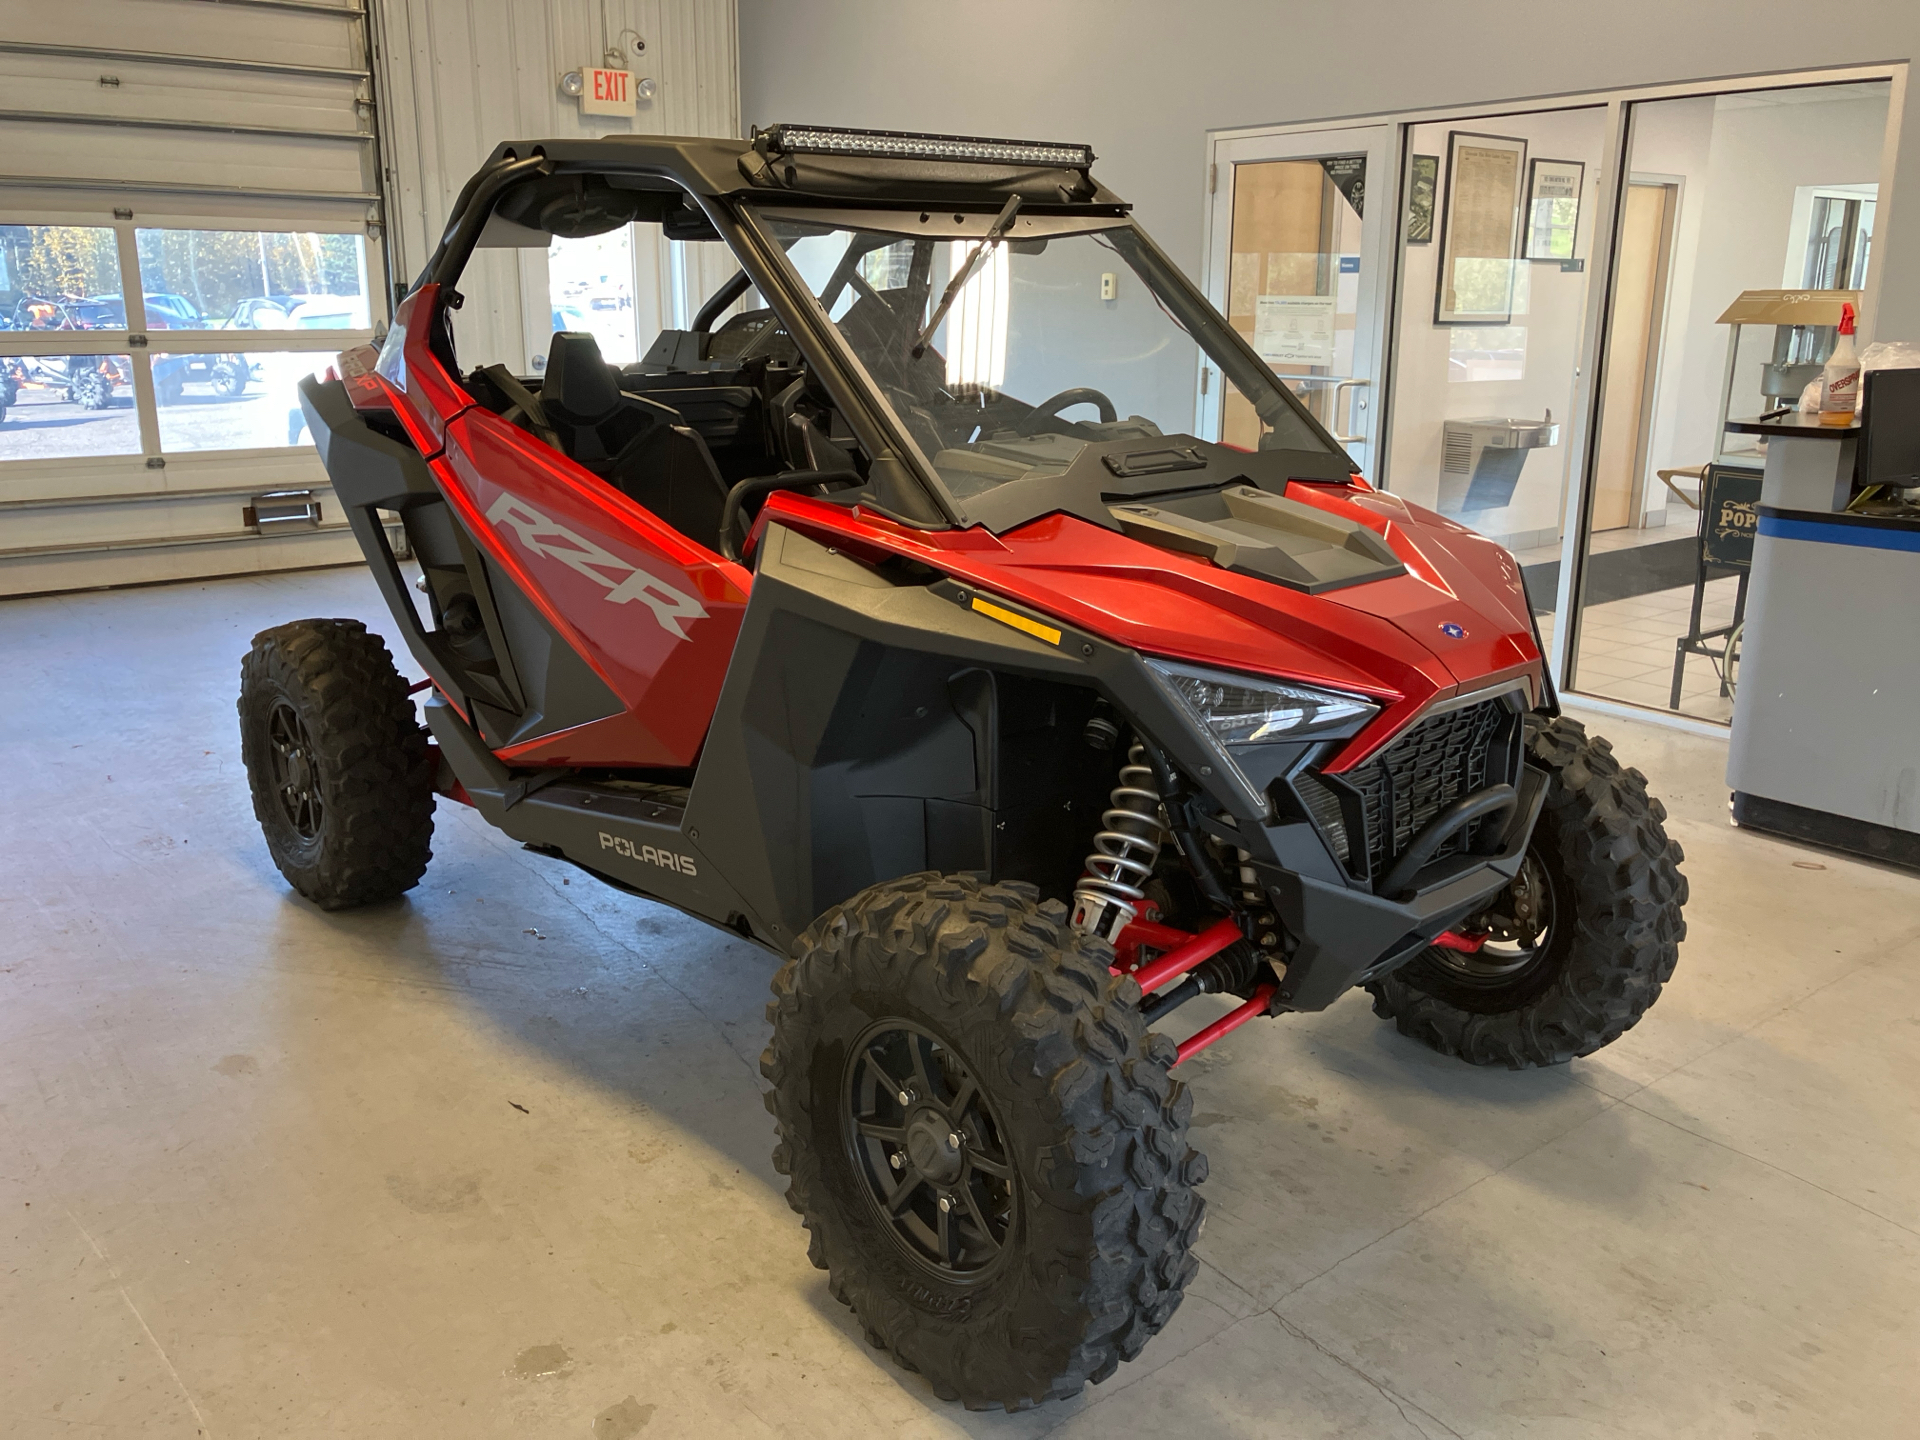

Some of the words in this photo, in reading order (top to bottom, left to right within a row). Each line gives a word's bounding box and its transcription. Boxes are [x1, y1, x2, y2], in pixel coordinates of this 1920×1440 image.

[594, 70, 628, 102] EXIT
[341, 354, 368, 378] PRO
[353, 373, 379, 391] XP
[1719, 508, 1758, 528] POP
[485, 491, 711, 643] RZR
[599, 831, 697, 876] POLARIS
